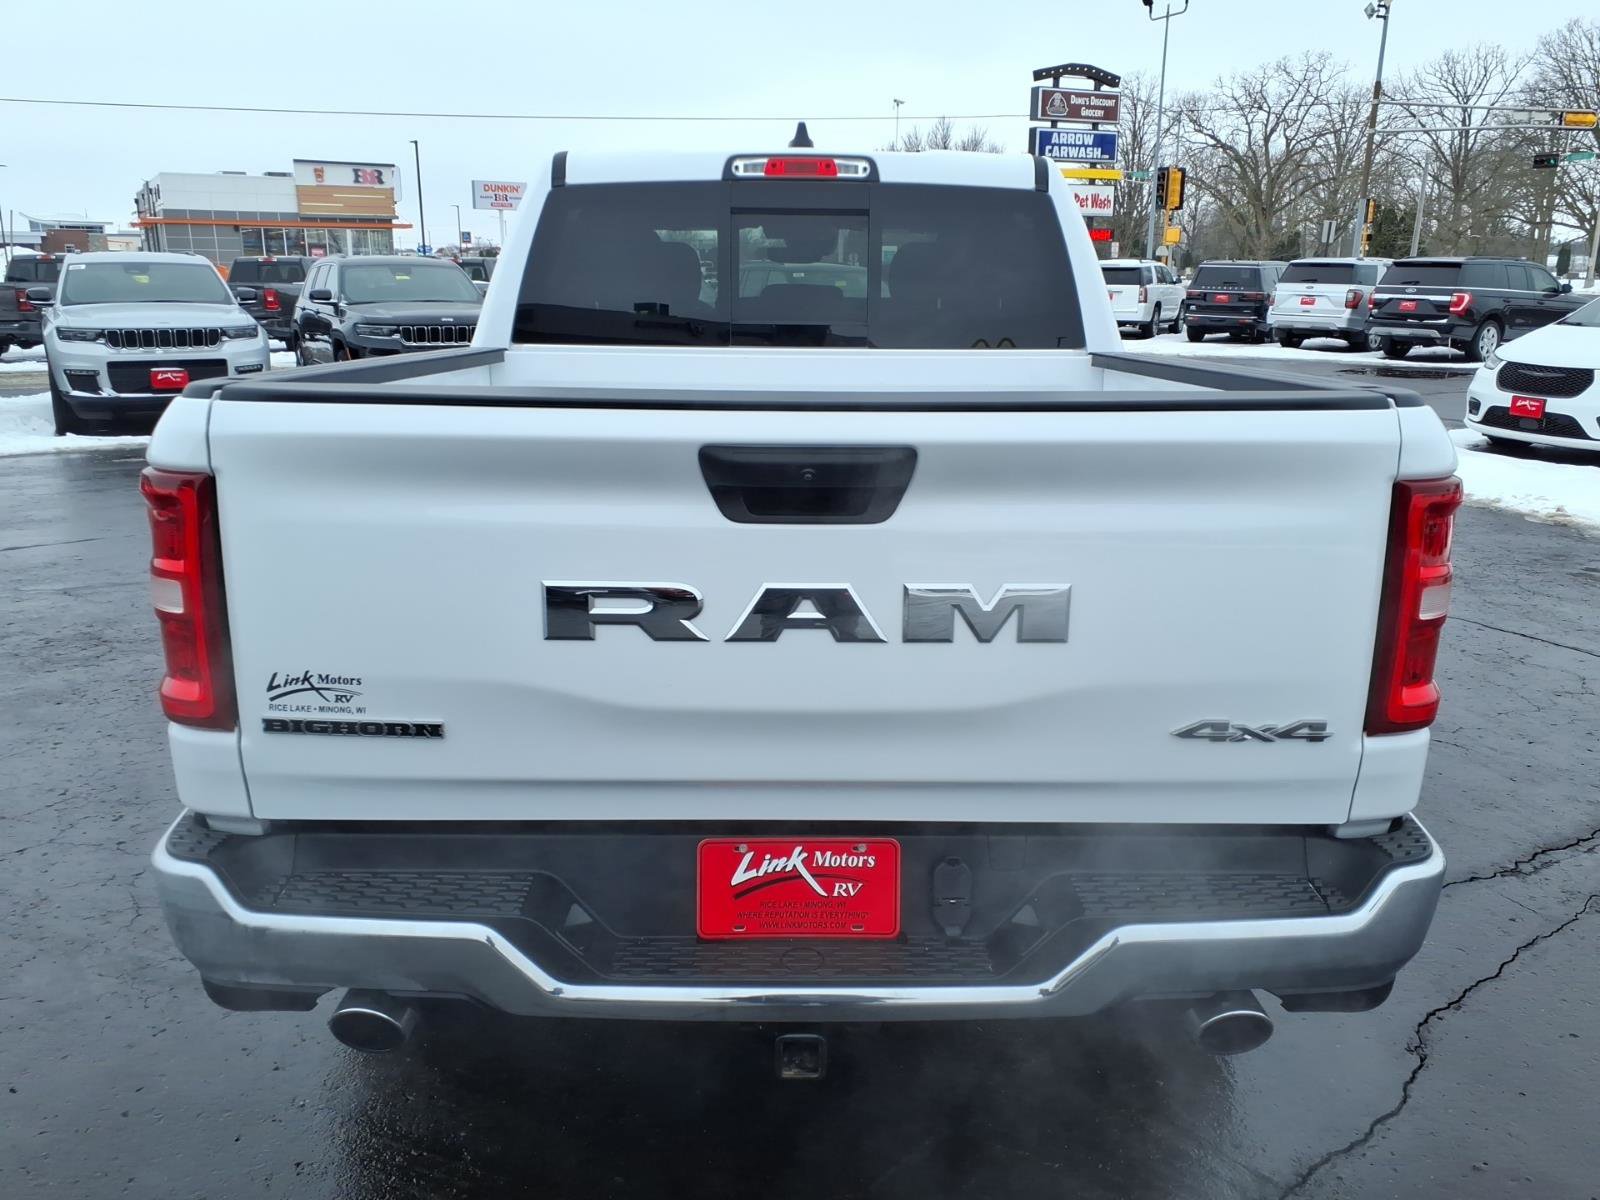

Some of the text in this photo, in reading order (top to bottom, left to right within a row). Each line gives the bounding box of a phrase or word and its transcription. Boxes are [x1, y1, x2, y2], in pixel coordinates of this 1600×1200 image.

[1080, 106, 1104, 118] GROCERY
[1051, 132, 1094, 146] ARROW
[1074, 192, 1111, 209] Pet Wash
[541, 580, 1073, 644] RAM
[266, 670, 362, 703] Link Motors
[334, 694, 354, 703] RV
[269, 704, 288, 712] RICE
[318, 706, 354, 715] MINONG,
[262, 718, 445, 739] BIGHORN
[731, 845, 876, 897] Link Motors
[832, 882, 863, 897] RV
[764, 911, 809, 919] REPUTATION
